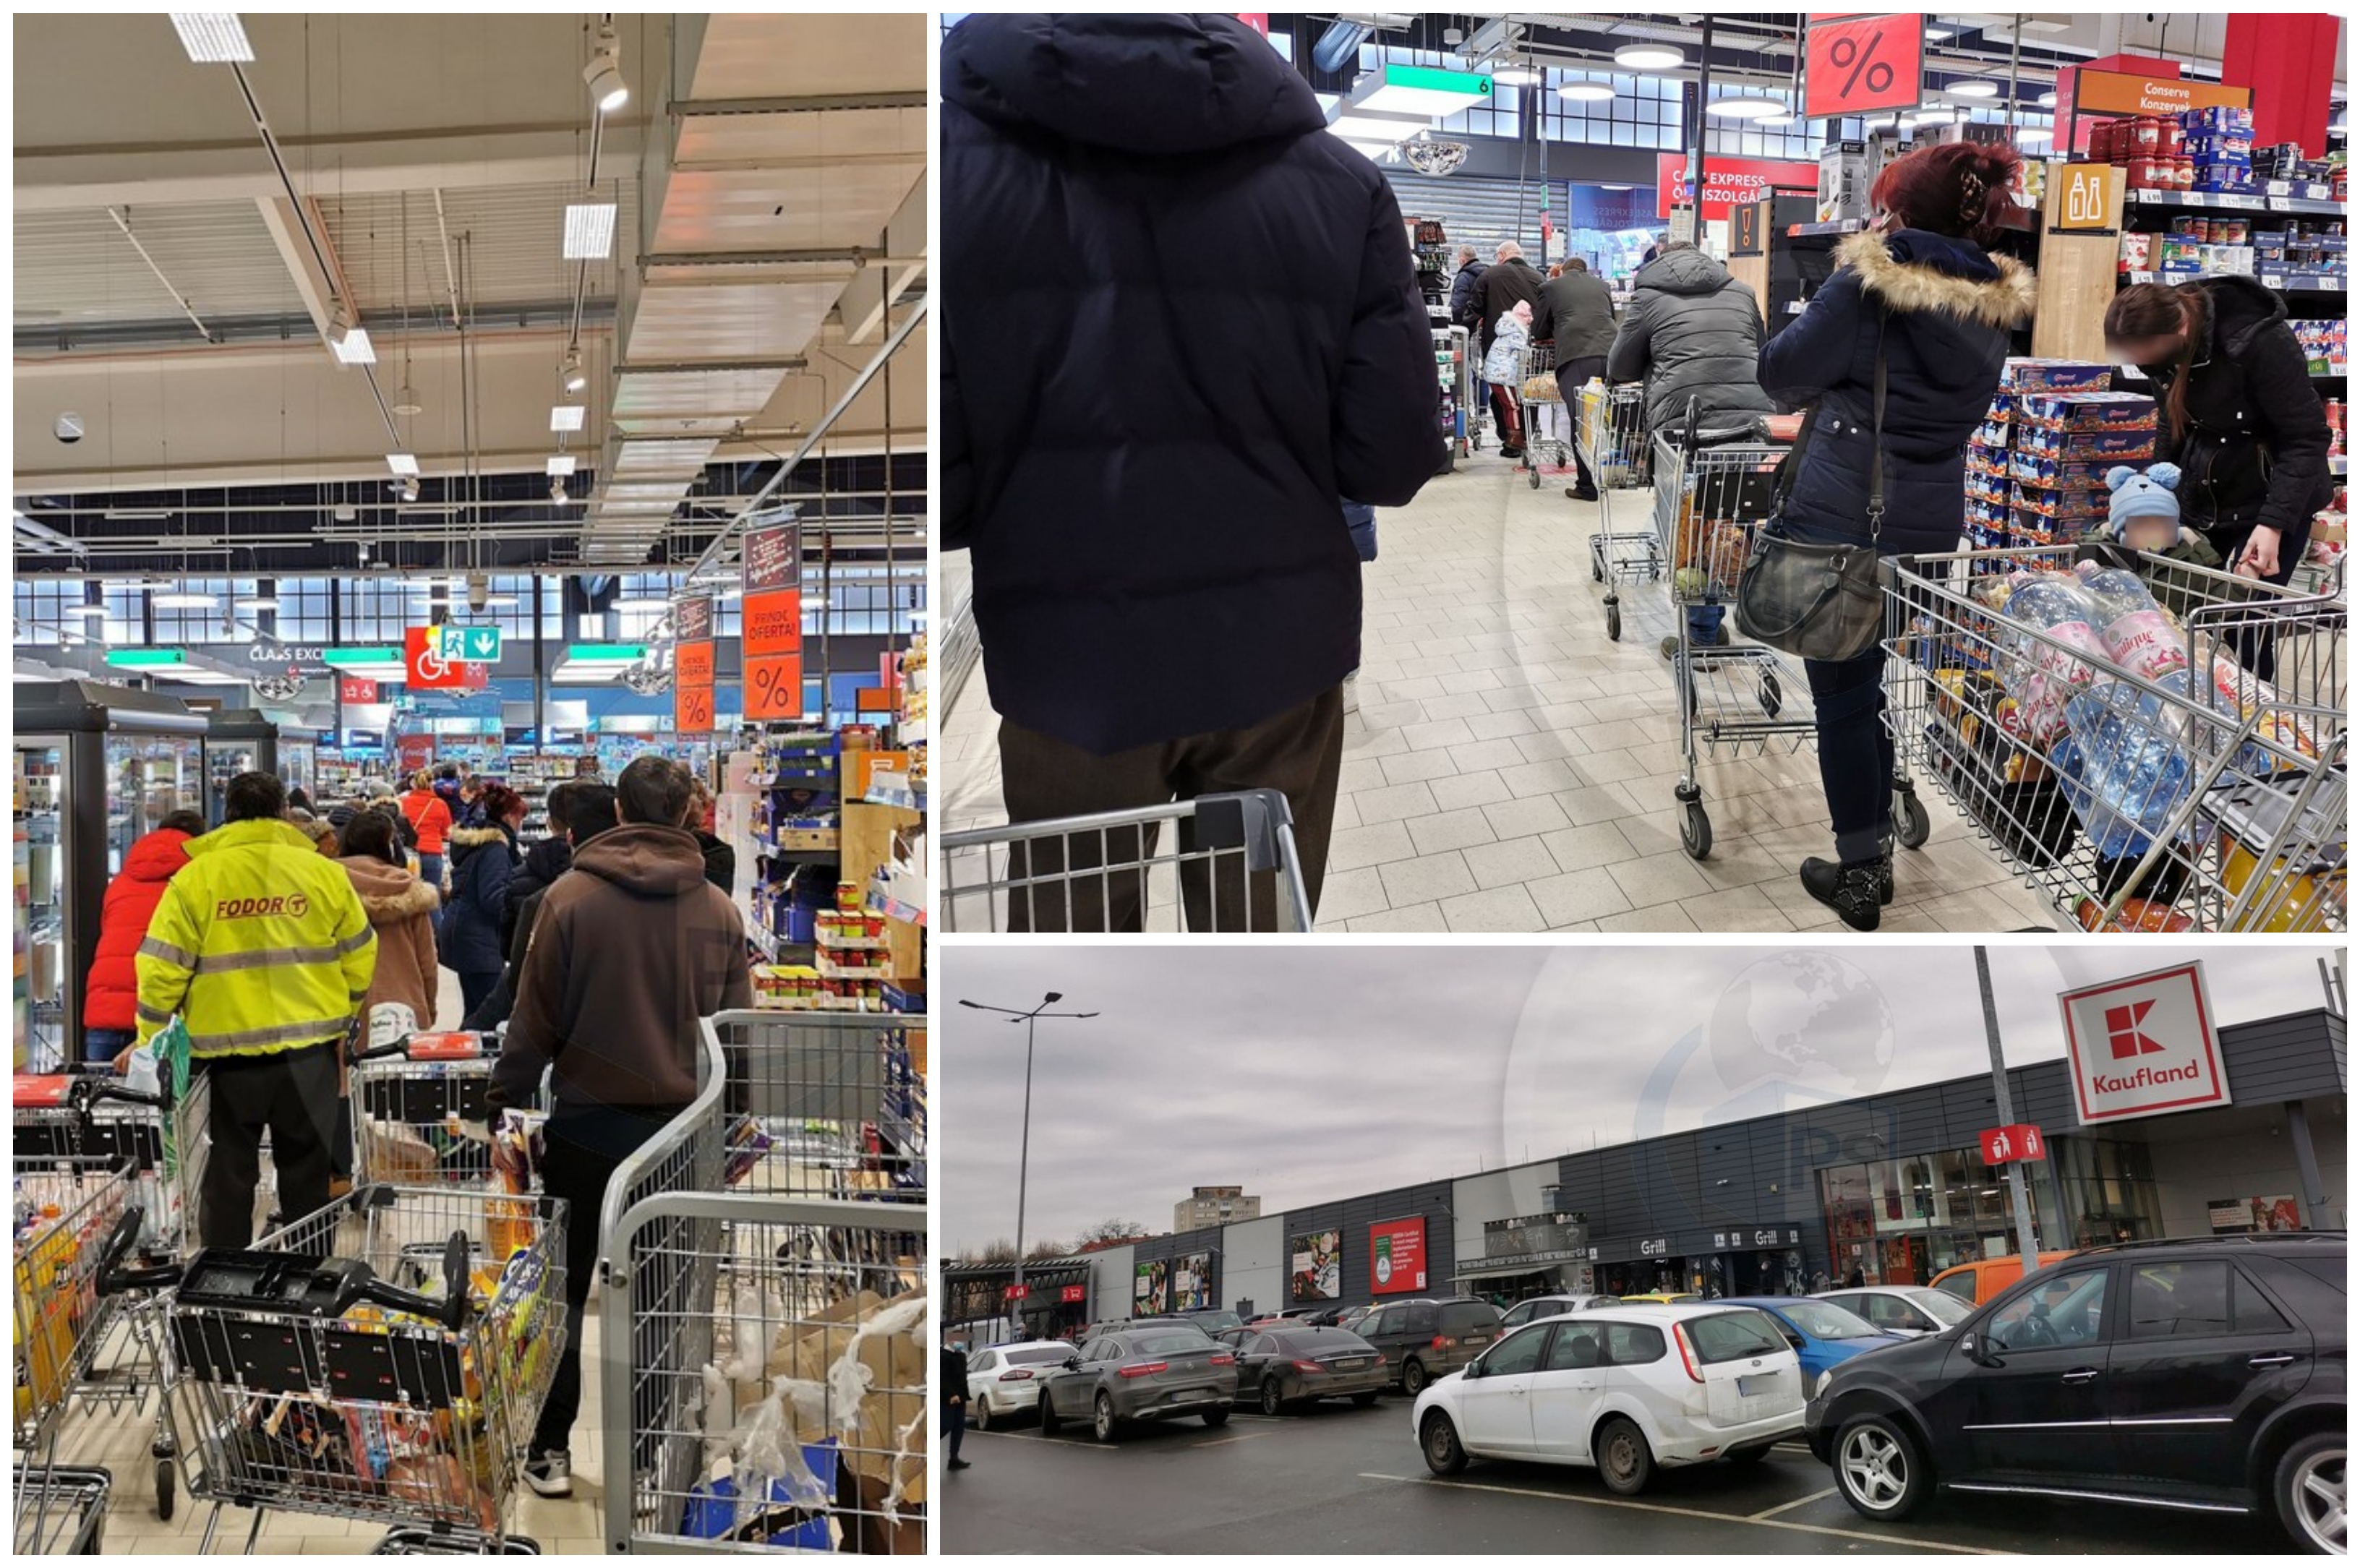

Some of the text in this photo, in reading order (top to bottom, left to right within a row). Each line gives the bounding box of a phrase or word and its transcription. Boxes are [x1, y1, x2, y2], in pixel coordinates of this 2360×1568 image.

[1479, 78, 1489, 93] 6
[2145, 82, 2190, 98] Conserve
[2140, 97, 2191, 112] Konzervek
[1710, 173, 1766, 187] EXPRESS
[749, 622, 796, 641] OFERTA!
[250, 644, 291, 661] CLAS
[391, 650, 398, 659] 5
[217, 896, 284, 918] FODOR
[2092, 1058, 2199, 1094] Kaufland
[1755, 1230, 1778, 1246] Grill
[1641, 1239, 1666, 1255] Grill
